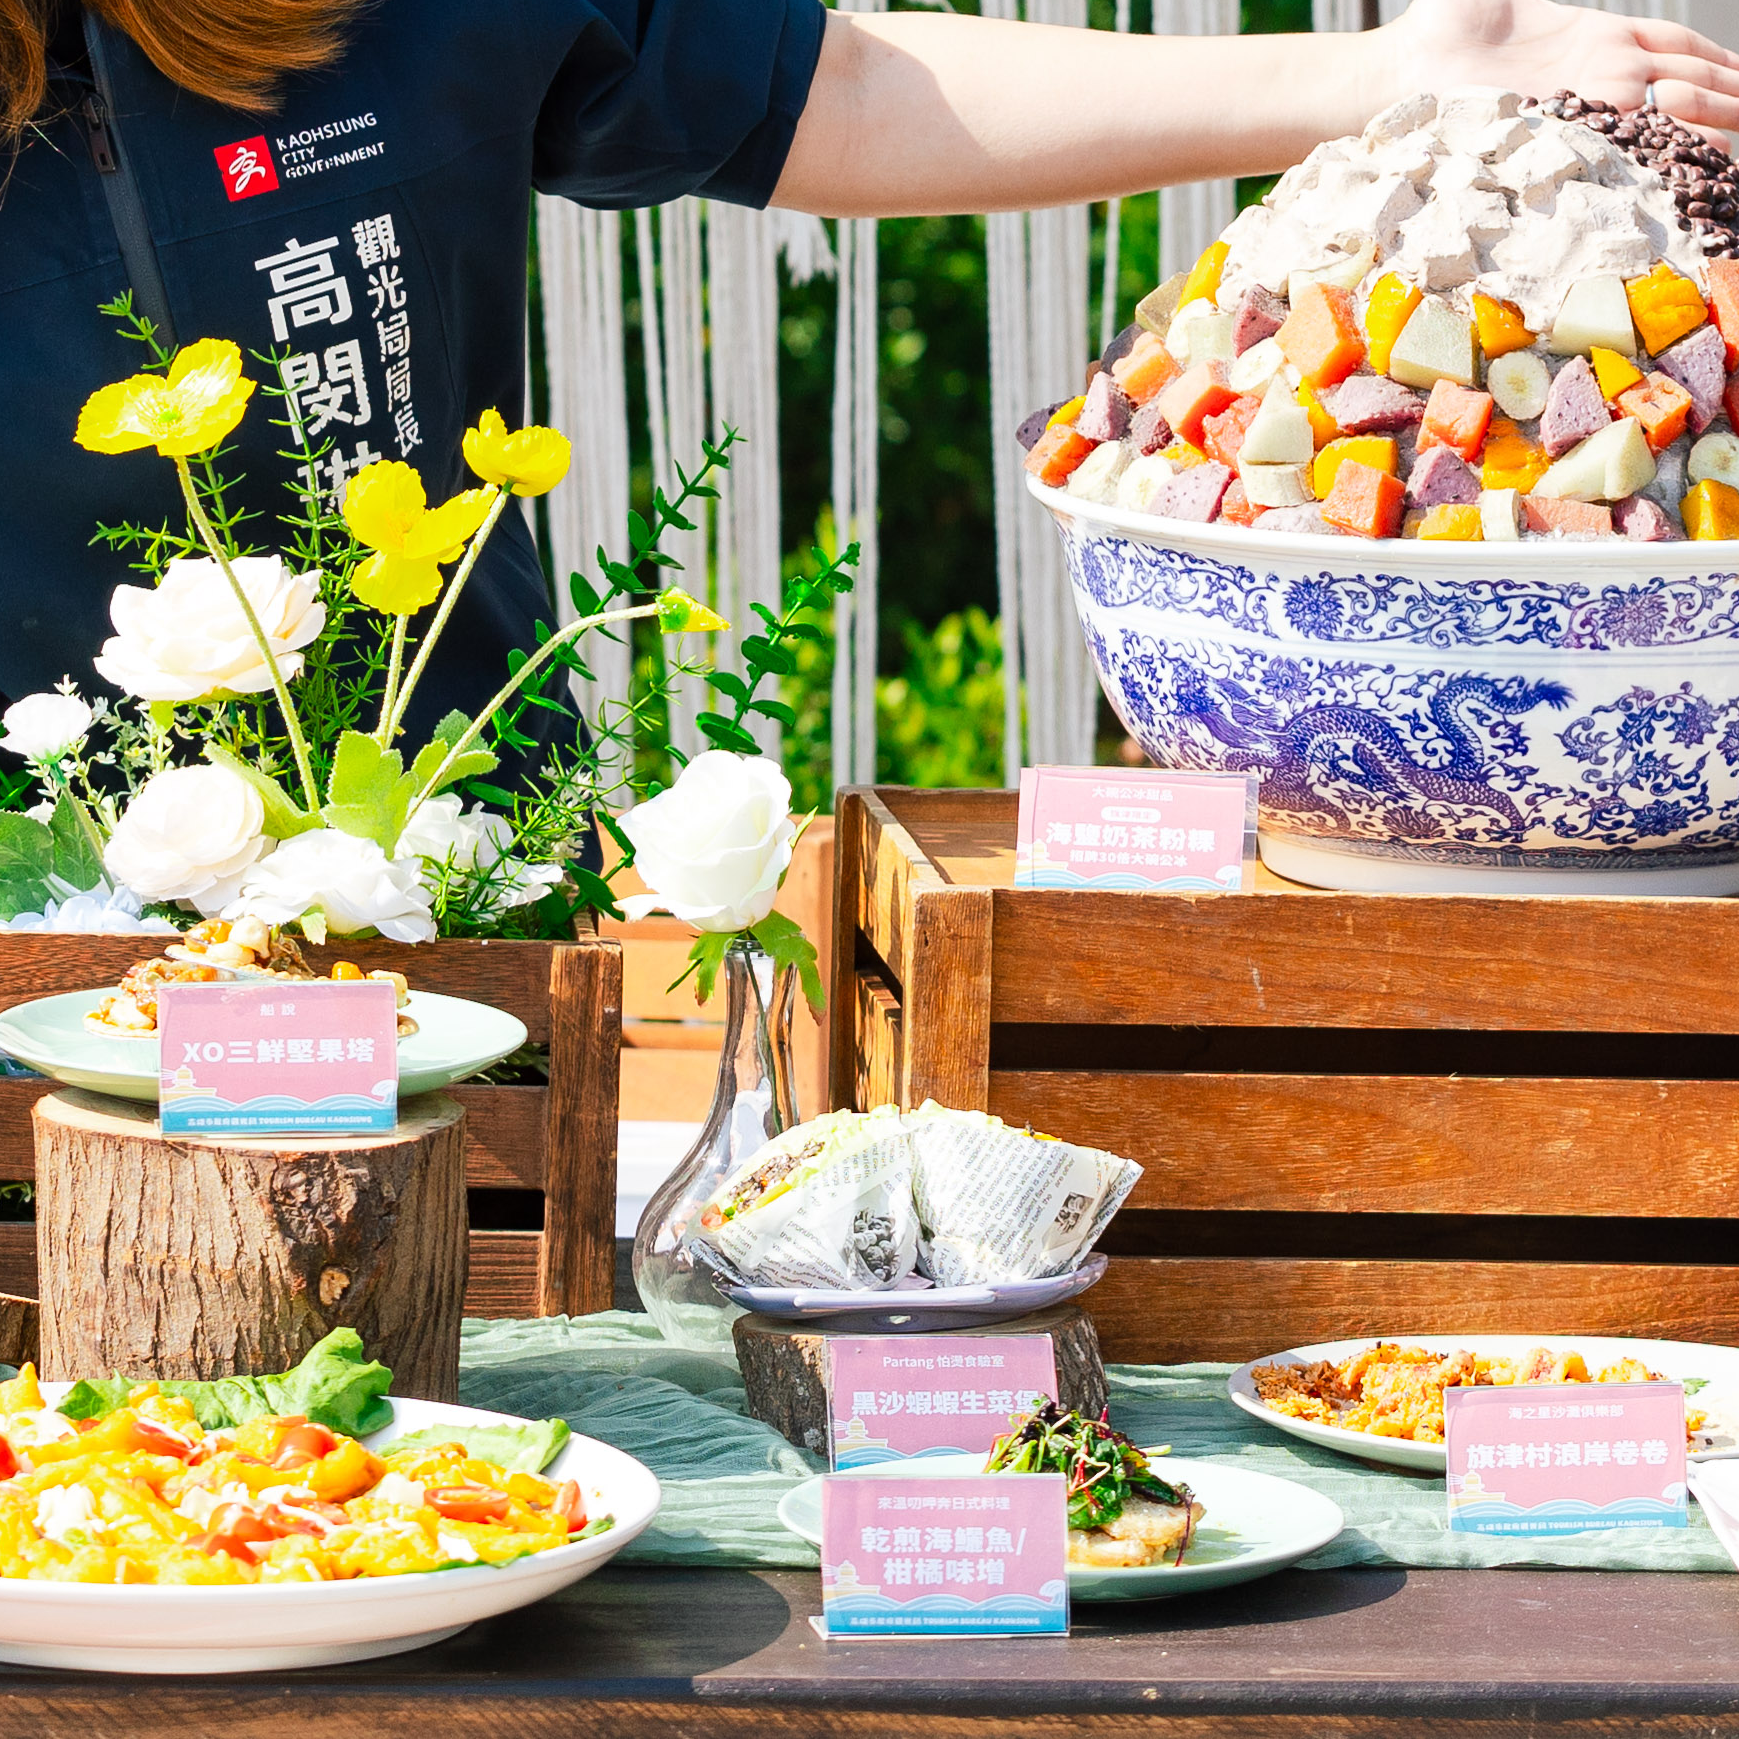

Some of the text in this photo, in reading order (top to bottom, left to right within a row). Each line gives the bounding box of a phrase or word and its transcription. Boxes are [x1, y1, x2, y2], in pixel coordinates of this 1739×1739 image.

[276, 112, 377, 152] KAOHSIUNG
[281, 146, 315, 165] CITY
[285, 141, 385, 179] GOVERNMENT
[351, 213, 423, 458] 觀光局局長
[1045, 821, 1216, 853] 海鹽奶茶粉粿
[182, 1038, 375, 1064] XO三鮮堅果塔
[883, 1356, 934, 1369] Partang
[851, 1390, 1040, 1417] 黑沙蝦蝦生菜堡
[883, 1557, 1006, 1586] 柑橘味增
